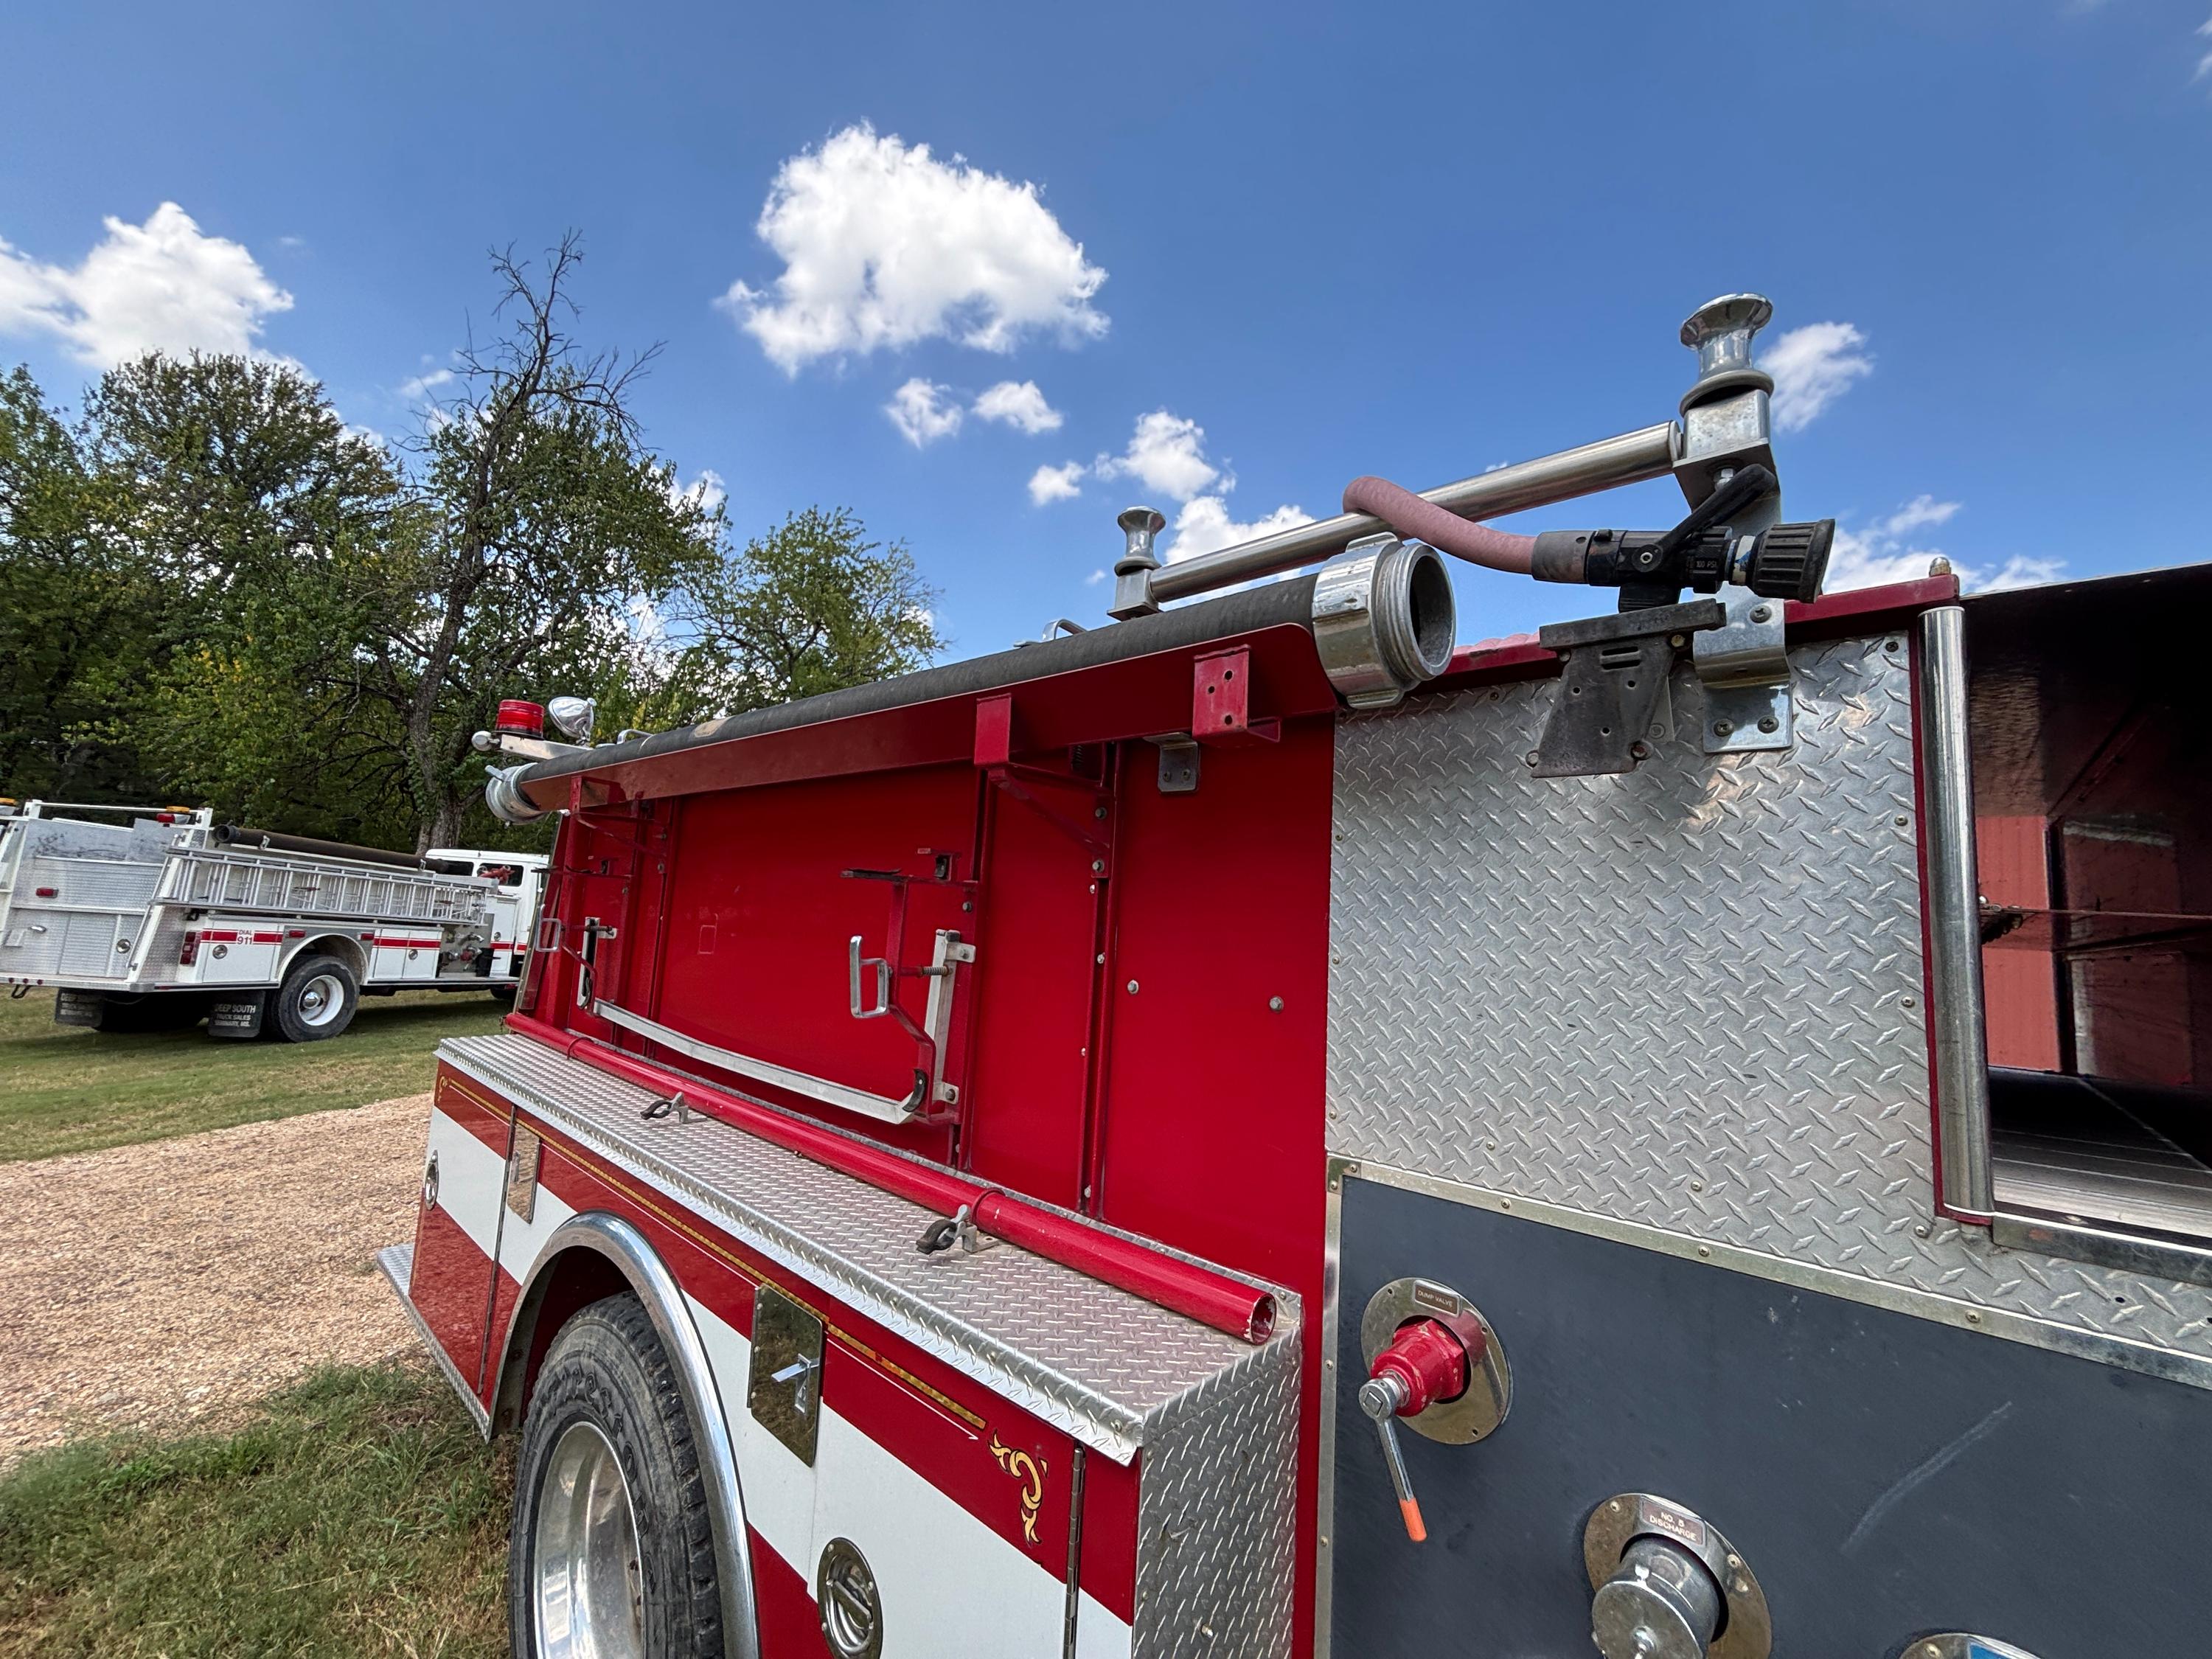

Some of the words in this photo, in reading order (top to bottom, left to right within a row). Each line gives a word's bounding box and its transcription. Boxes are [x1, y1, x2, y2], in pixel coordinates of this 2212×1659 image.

[237, 936, 252, 945] 911
[232, 1004, 257, 1014] SOUTH
[1418, 1290, 1434, 1299] DUMP
[1435, 1296, 1453, 1307] VALVE
[1660, 1512, 1676, 1524] NO.
[1649, 1514, 1697, 1541] DISCHARGE
